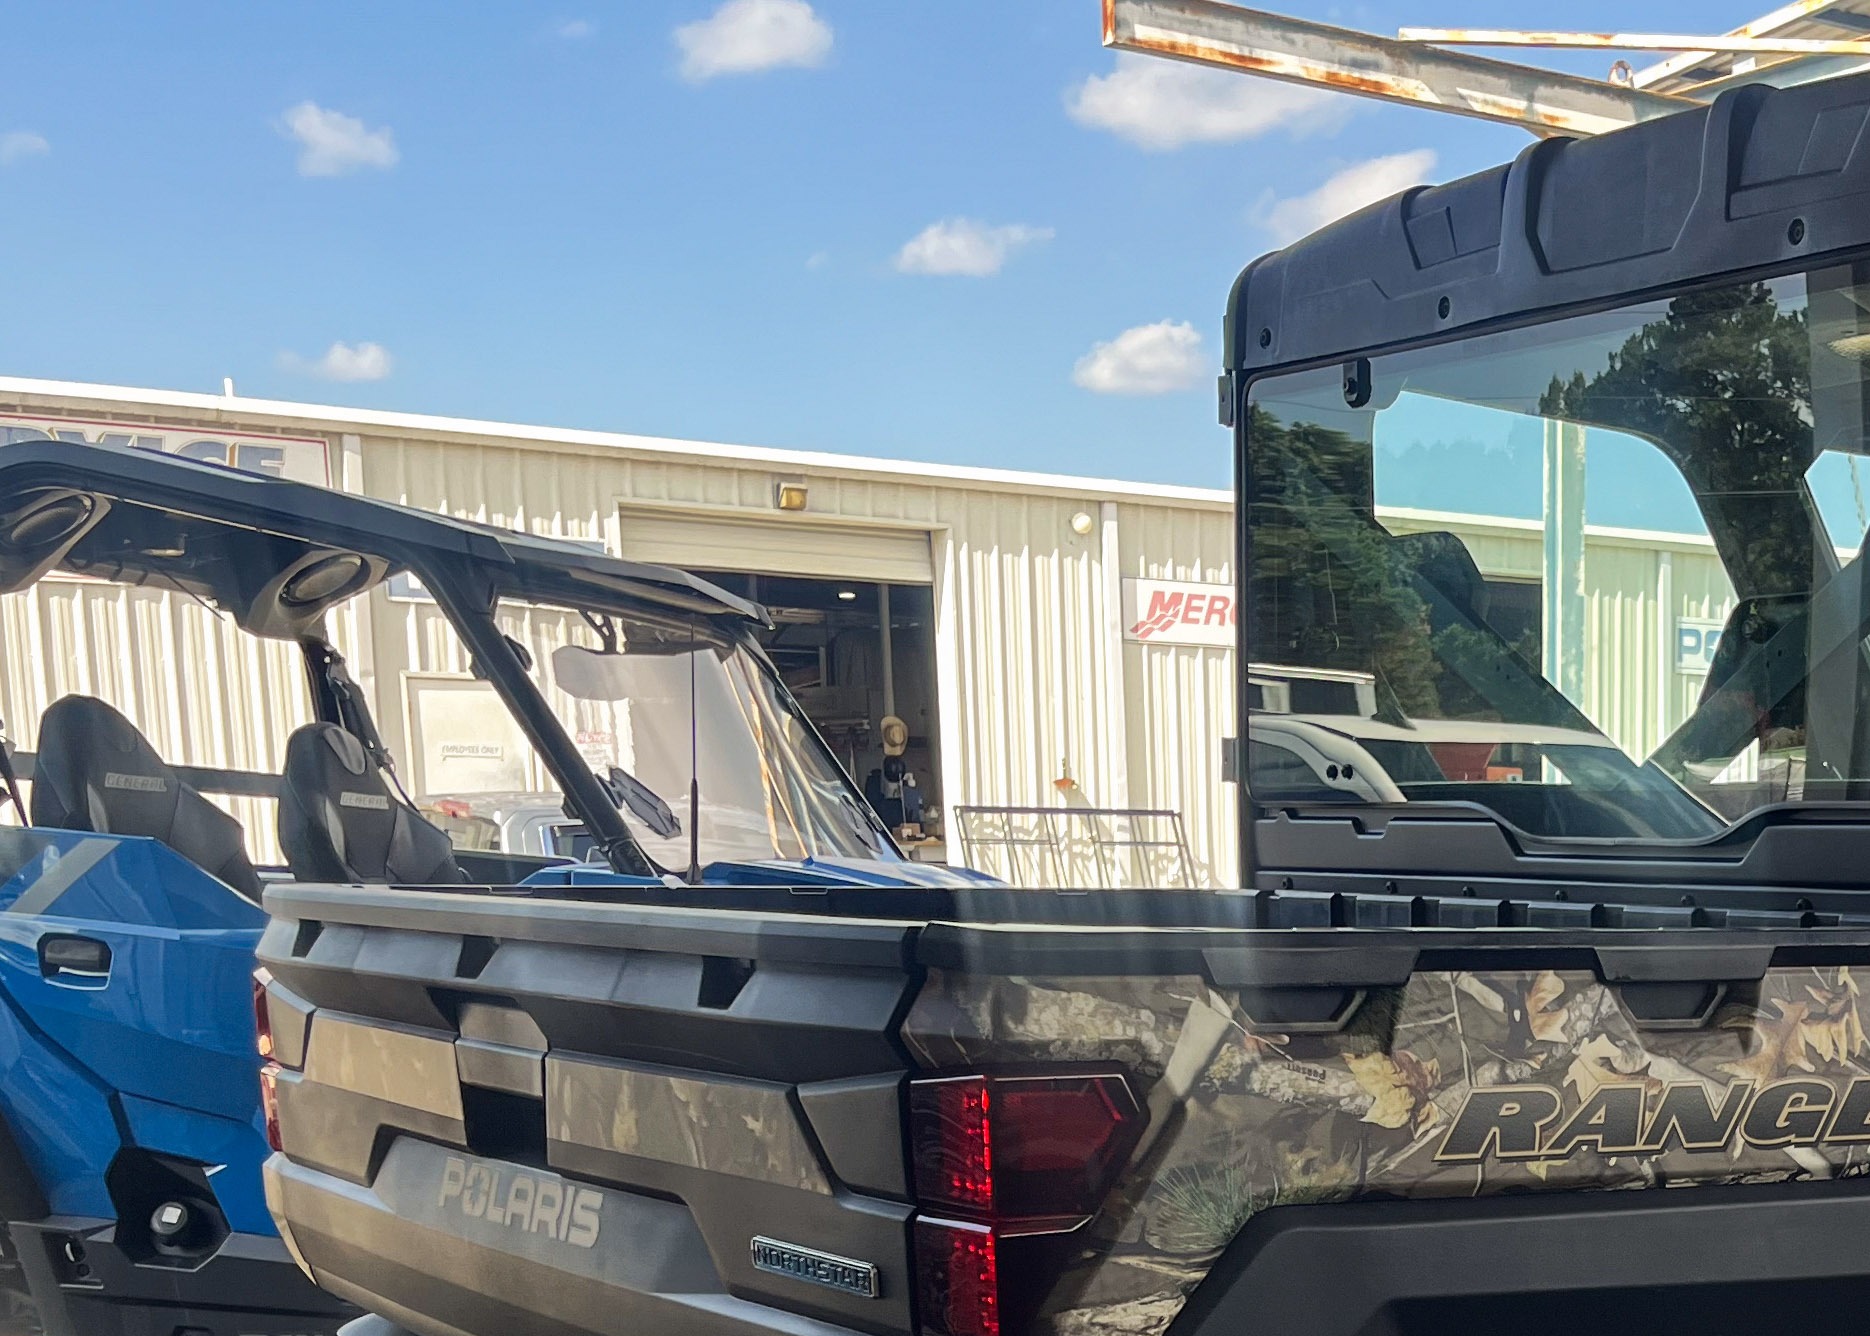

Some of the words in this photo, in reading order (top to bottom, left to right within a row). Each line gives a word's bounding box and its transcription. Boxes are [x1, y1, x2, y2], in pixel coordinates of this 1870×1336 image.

[1129, 590, 1236, 638] MER
[438, 1156, 604, 1249] POLARIS
[756, 1243, 871, 1294] NORTHSTAR
